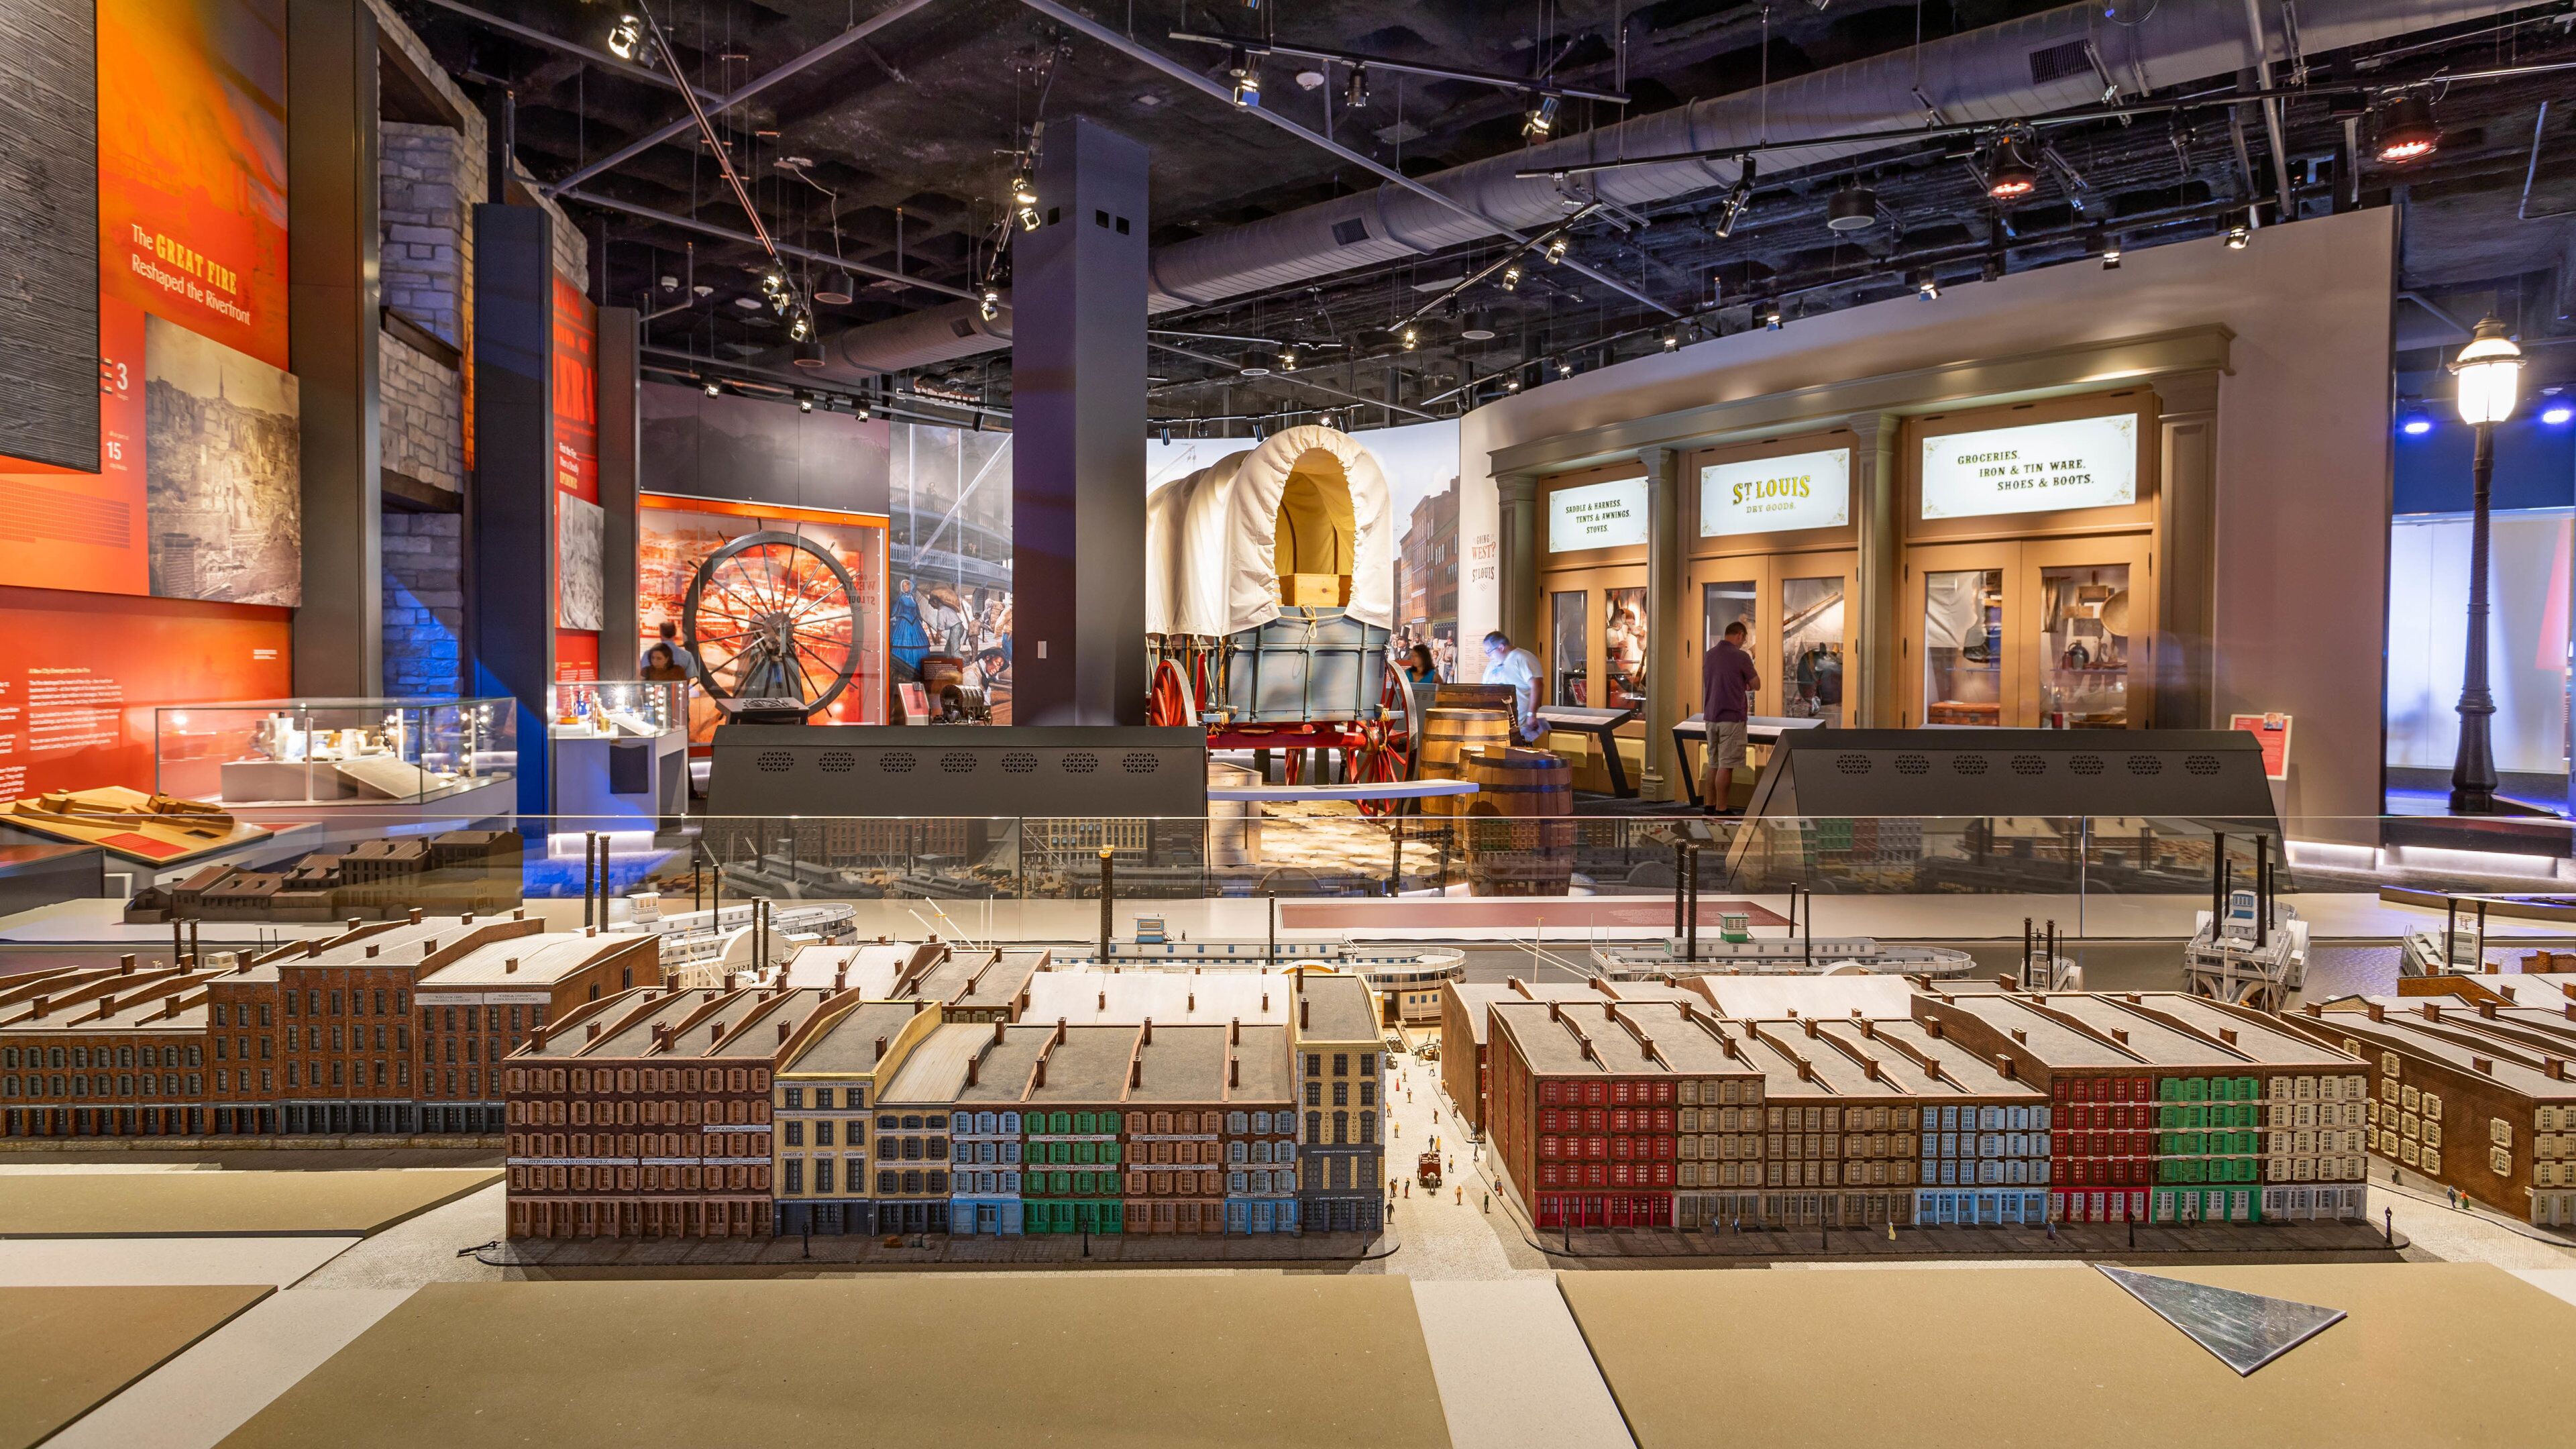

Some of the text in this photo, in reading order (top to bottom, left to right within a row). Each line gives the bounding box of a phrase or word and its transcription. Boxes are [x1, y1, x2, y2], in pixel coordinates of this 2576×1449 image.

[131, 223, 237, 295] The GREAT FIRE
[132, 253, 250, 325] Reshaped the Riverfront
[117, 362, 128, 390] 3
[107, 441, 122, 461] 15
[1957, 450, 2021, 465] GROCERIES.
[1980, 460, 2086, 477] IRON & TIN WARE.
[1756, 475, 1811, 498] LOUIS
[1998, 474, 2094, 490] SHOES & BOOTS.
[1565, 504, 1586, 514] SADDLE
[1594, 499, 1622, 510] HARNESS.
[1746, 502, 1796, 513] DRY GOODS.
[1576, 510, 1631, 523] TENTS & AWNINGS.
[1587, 525, 1609, 534] STOVES.
[1472, 541, 1496, 560] WEST?
[1478, 566, 1495, 580] LOUIS
